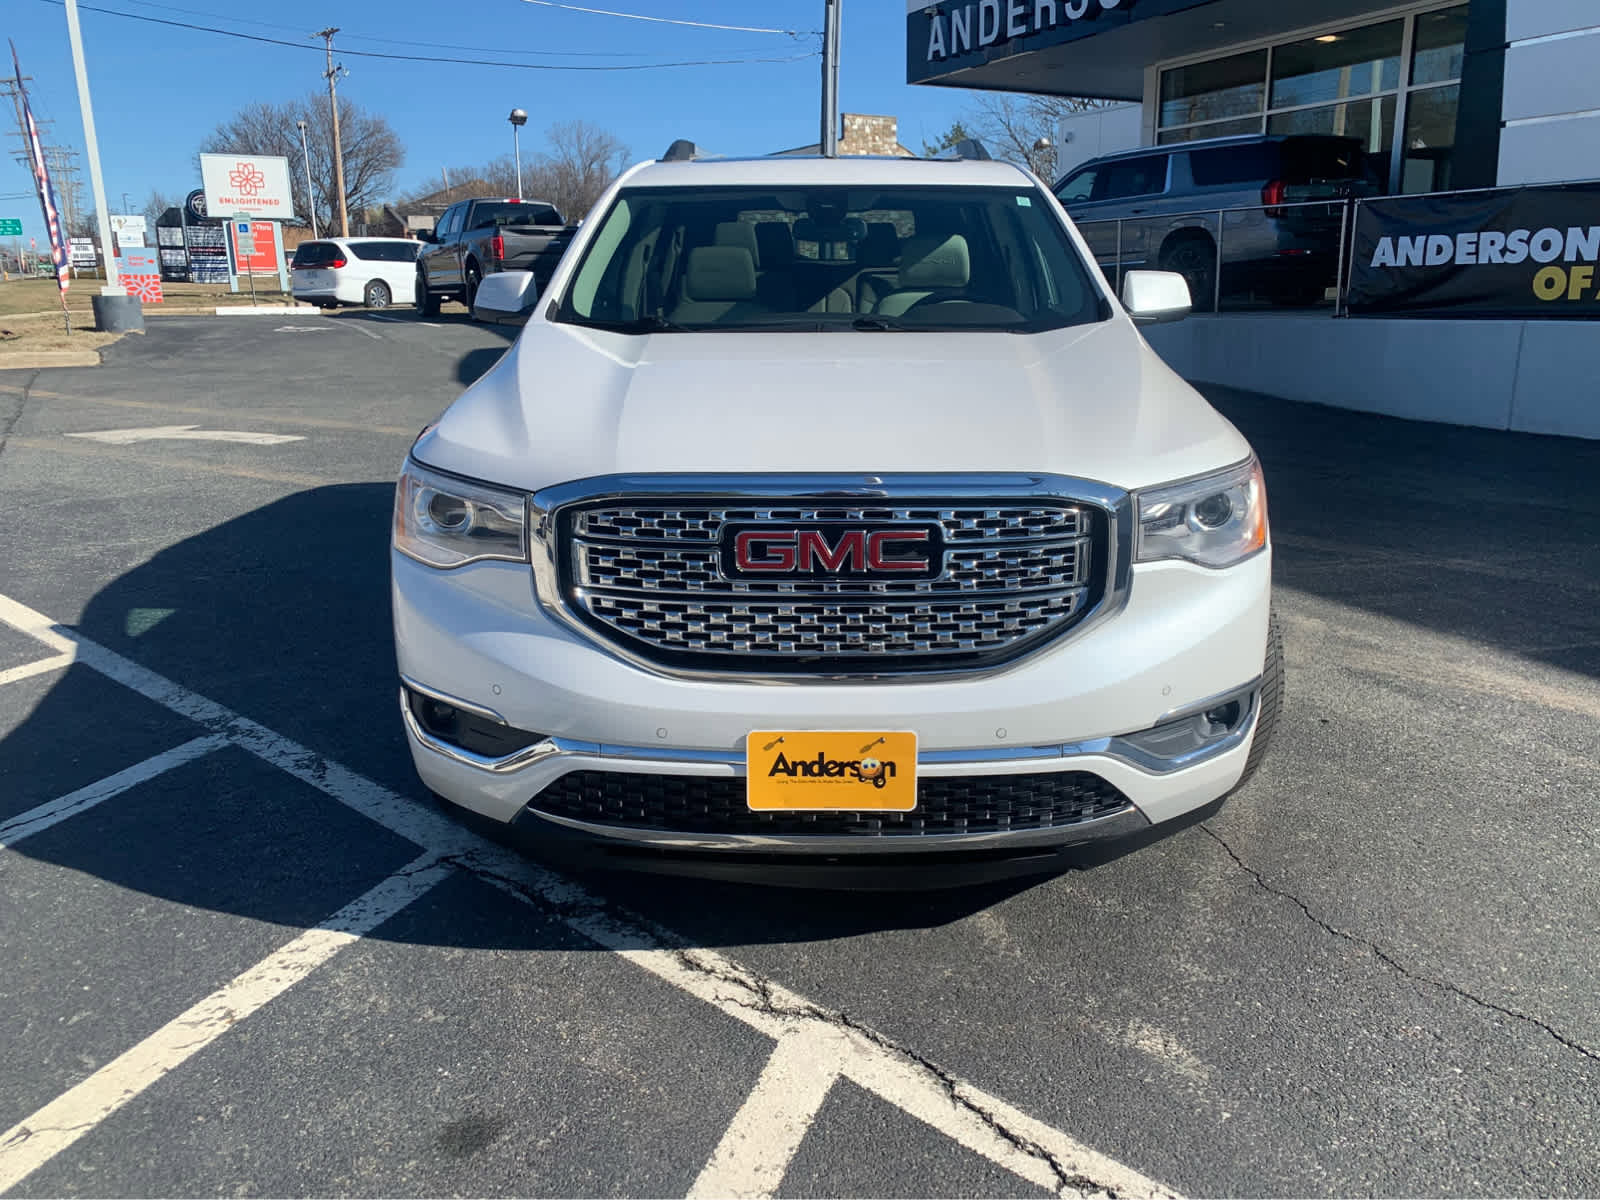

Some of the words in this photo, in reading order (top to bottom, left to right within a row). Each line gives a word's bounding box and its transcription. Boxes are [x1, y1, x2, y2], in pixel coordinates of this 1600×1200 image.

[218, 196, 280, 206] ENLIGHTENED
[1370, 226, 1600, 267] ANDERSON
[1532, 265, 1594, 301] OF
[735, 529, 929, 573] GMC
[768, 751, 897, 780] Anderson
